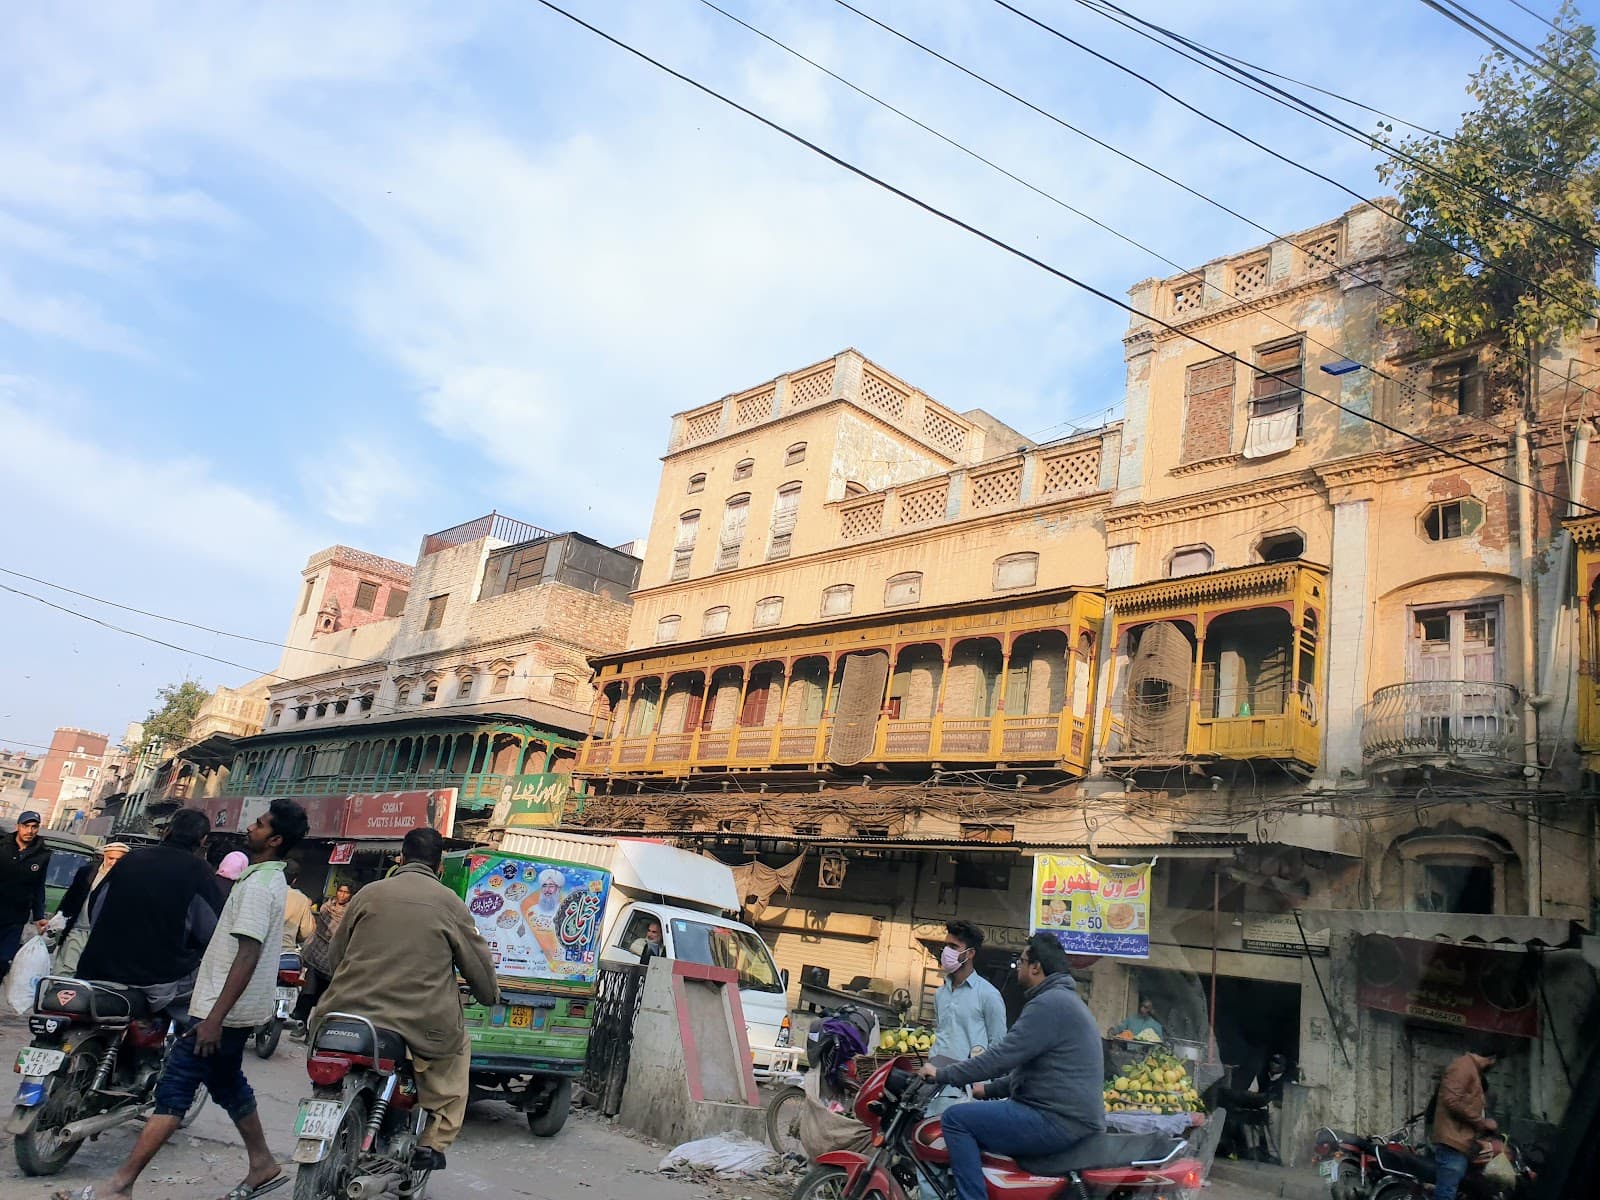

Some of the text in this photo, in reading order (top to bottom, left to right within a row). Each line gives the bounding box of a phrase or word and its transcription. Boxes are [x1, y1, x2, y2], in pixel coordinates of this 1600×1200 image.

[367, 815, 390, 828] SWEETS
[394, 815, 416, 828] BAKERS
[1087, 916, 1102, 929] 50
[583, 950, 595, 963] 15
[512, 1016, 523, 1026] 43
[326, 1029, 361, 1039] HONDA
